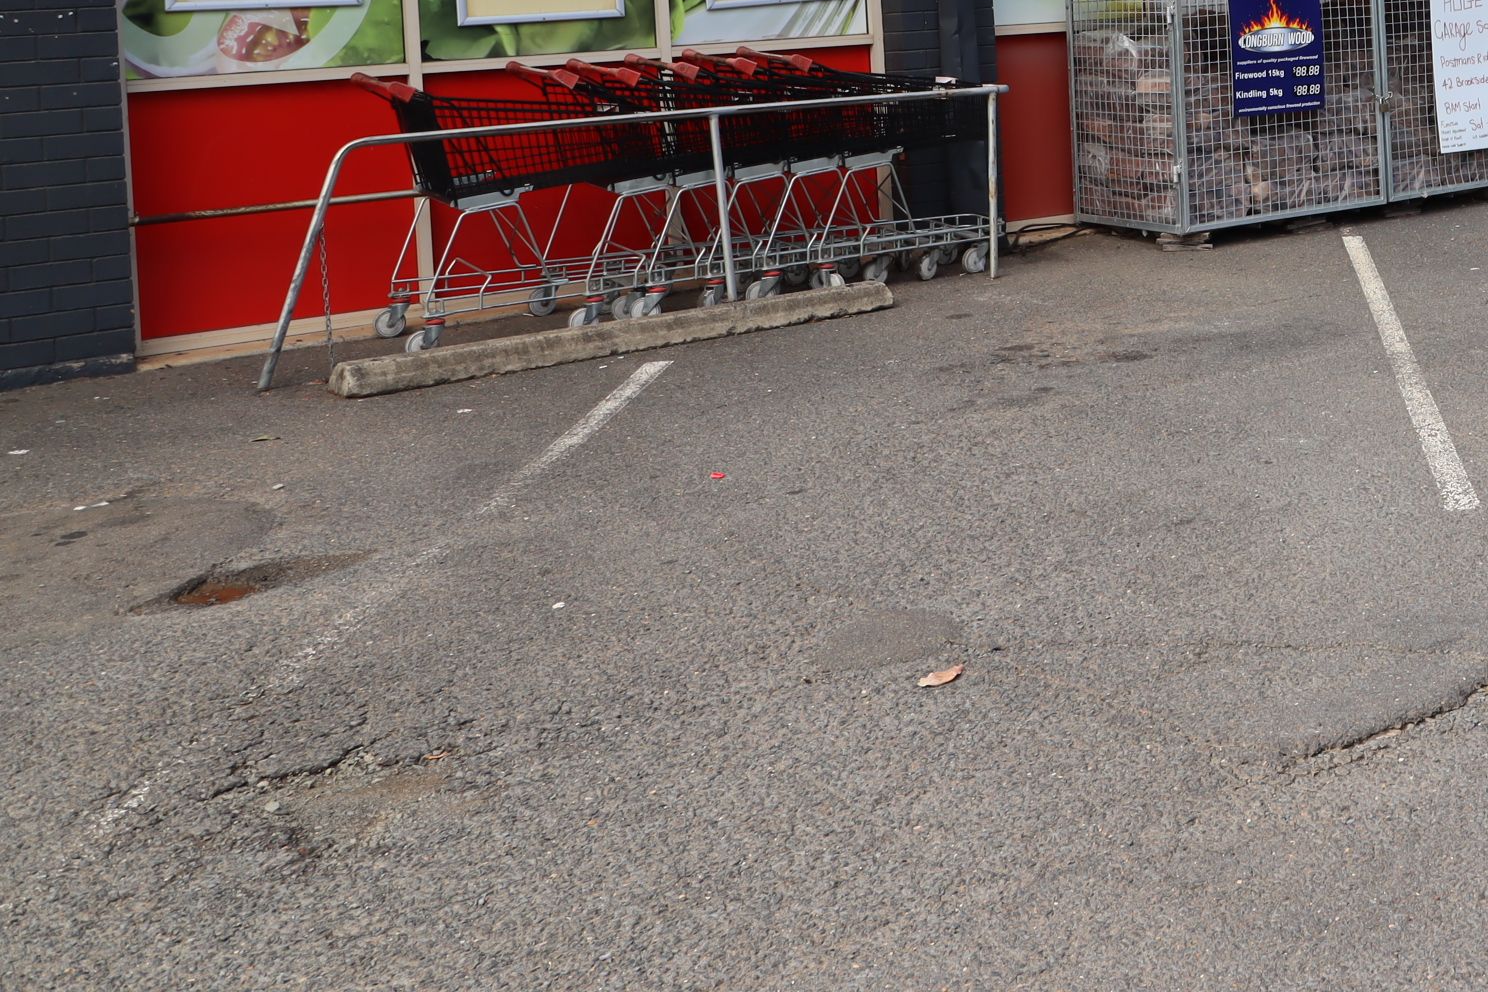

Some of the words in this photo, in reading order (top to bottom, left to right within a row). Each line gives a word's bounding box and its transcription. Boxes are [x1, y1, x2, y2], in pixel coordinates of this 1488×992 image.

[1241, 33, 1285, 49] LONGBURN
[1288, 31, 1313, 45] WOOD
[1440, 55, 1476, 69] Postmans
[1235, 70, 1267, 80] Firewood
[1268, 69, 1285, 78] 15kg
[1293, 65, 1320, 77] $88.88
[1236, 90, 1267, 99] Kindling
[1269, 88, 1283, 97] 5kg
[1294, 84, 1321, 96] $88.88
[1442, 79, 1453, 90] 42
[1444, 101, 1460, 115] 8AM
[1462, 97, 1481, 113] Start
